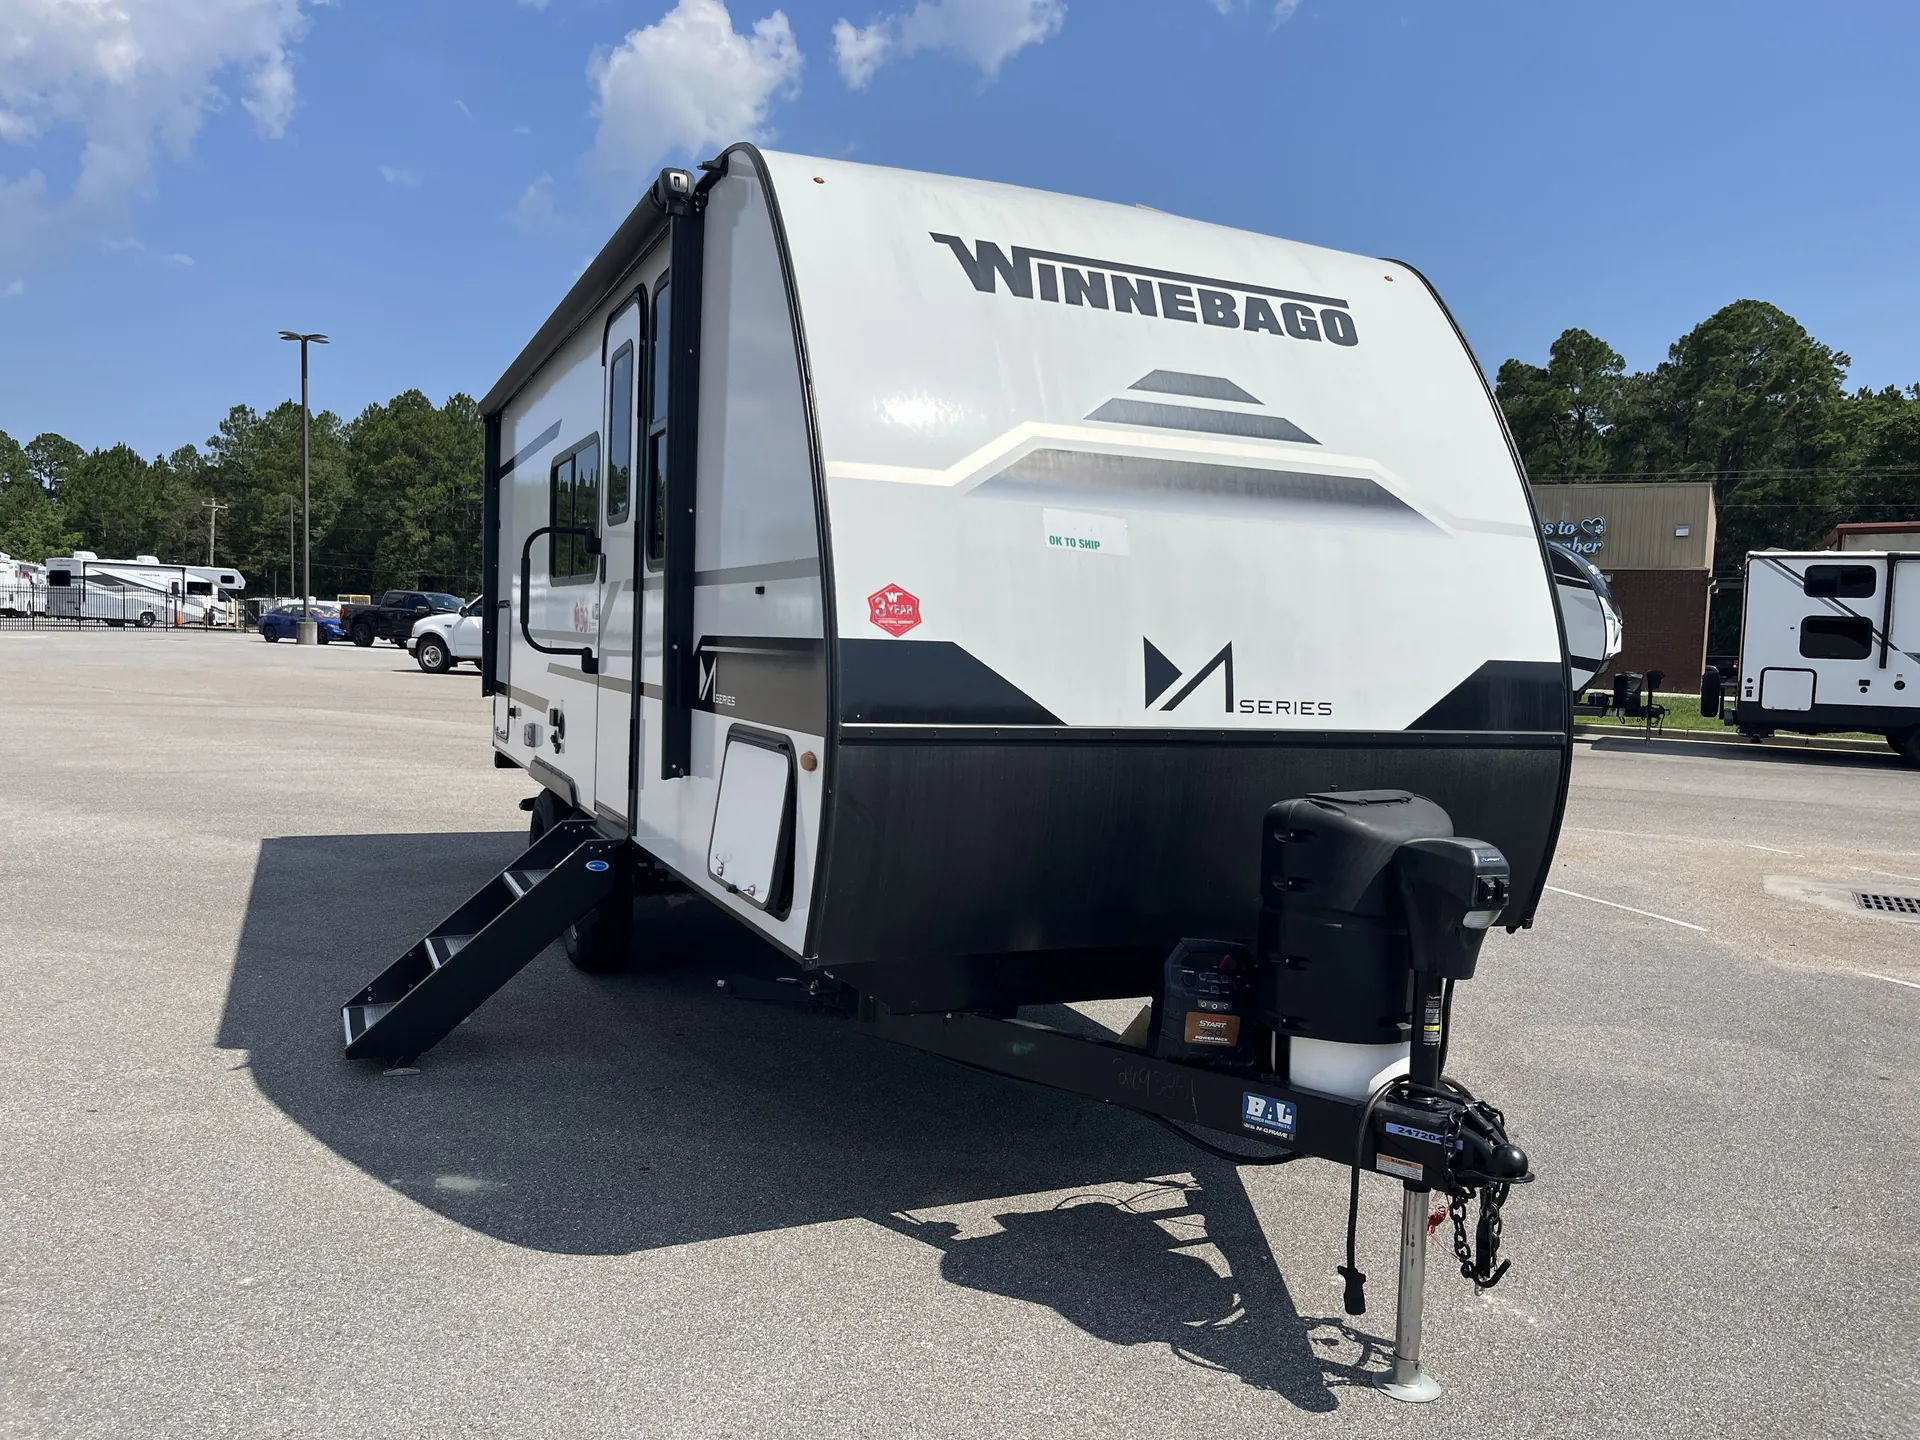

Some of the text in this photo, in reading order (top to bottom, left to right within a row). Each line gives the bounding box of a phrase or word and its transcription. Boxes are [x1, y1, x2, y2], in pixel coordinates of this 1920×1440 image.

[929, 232, 1358, 348] WINNEBAGO
[1557, 520, 1578, 535] to
[1049, 535, 1101, 550] OK TO SHIP
[874, 596, 913, 617] 3 YEAR
[715, 693, 736, 707] SERIES
[1239, 699, 1333, 716] SERIES
[1199, 1020, 1227, 1029] START
